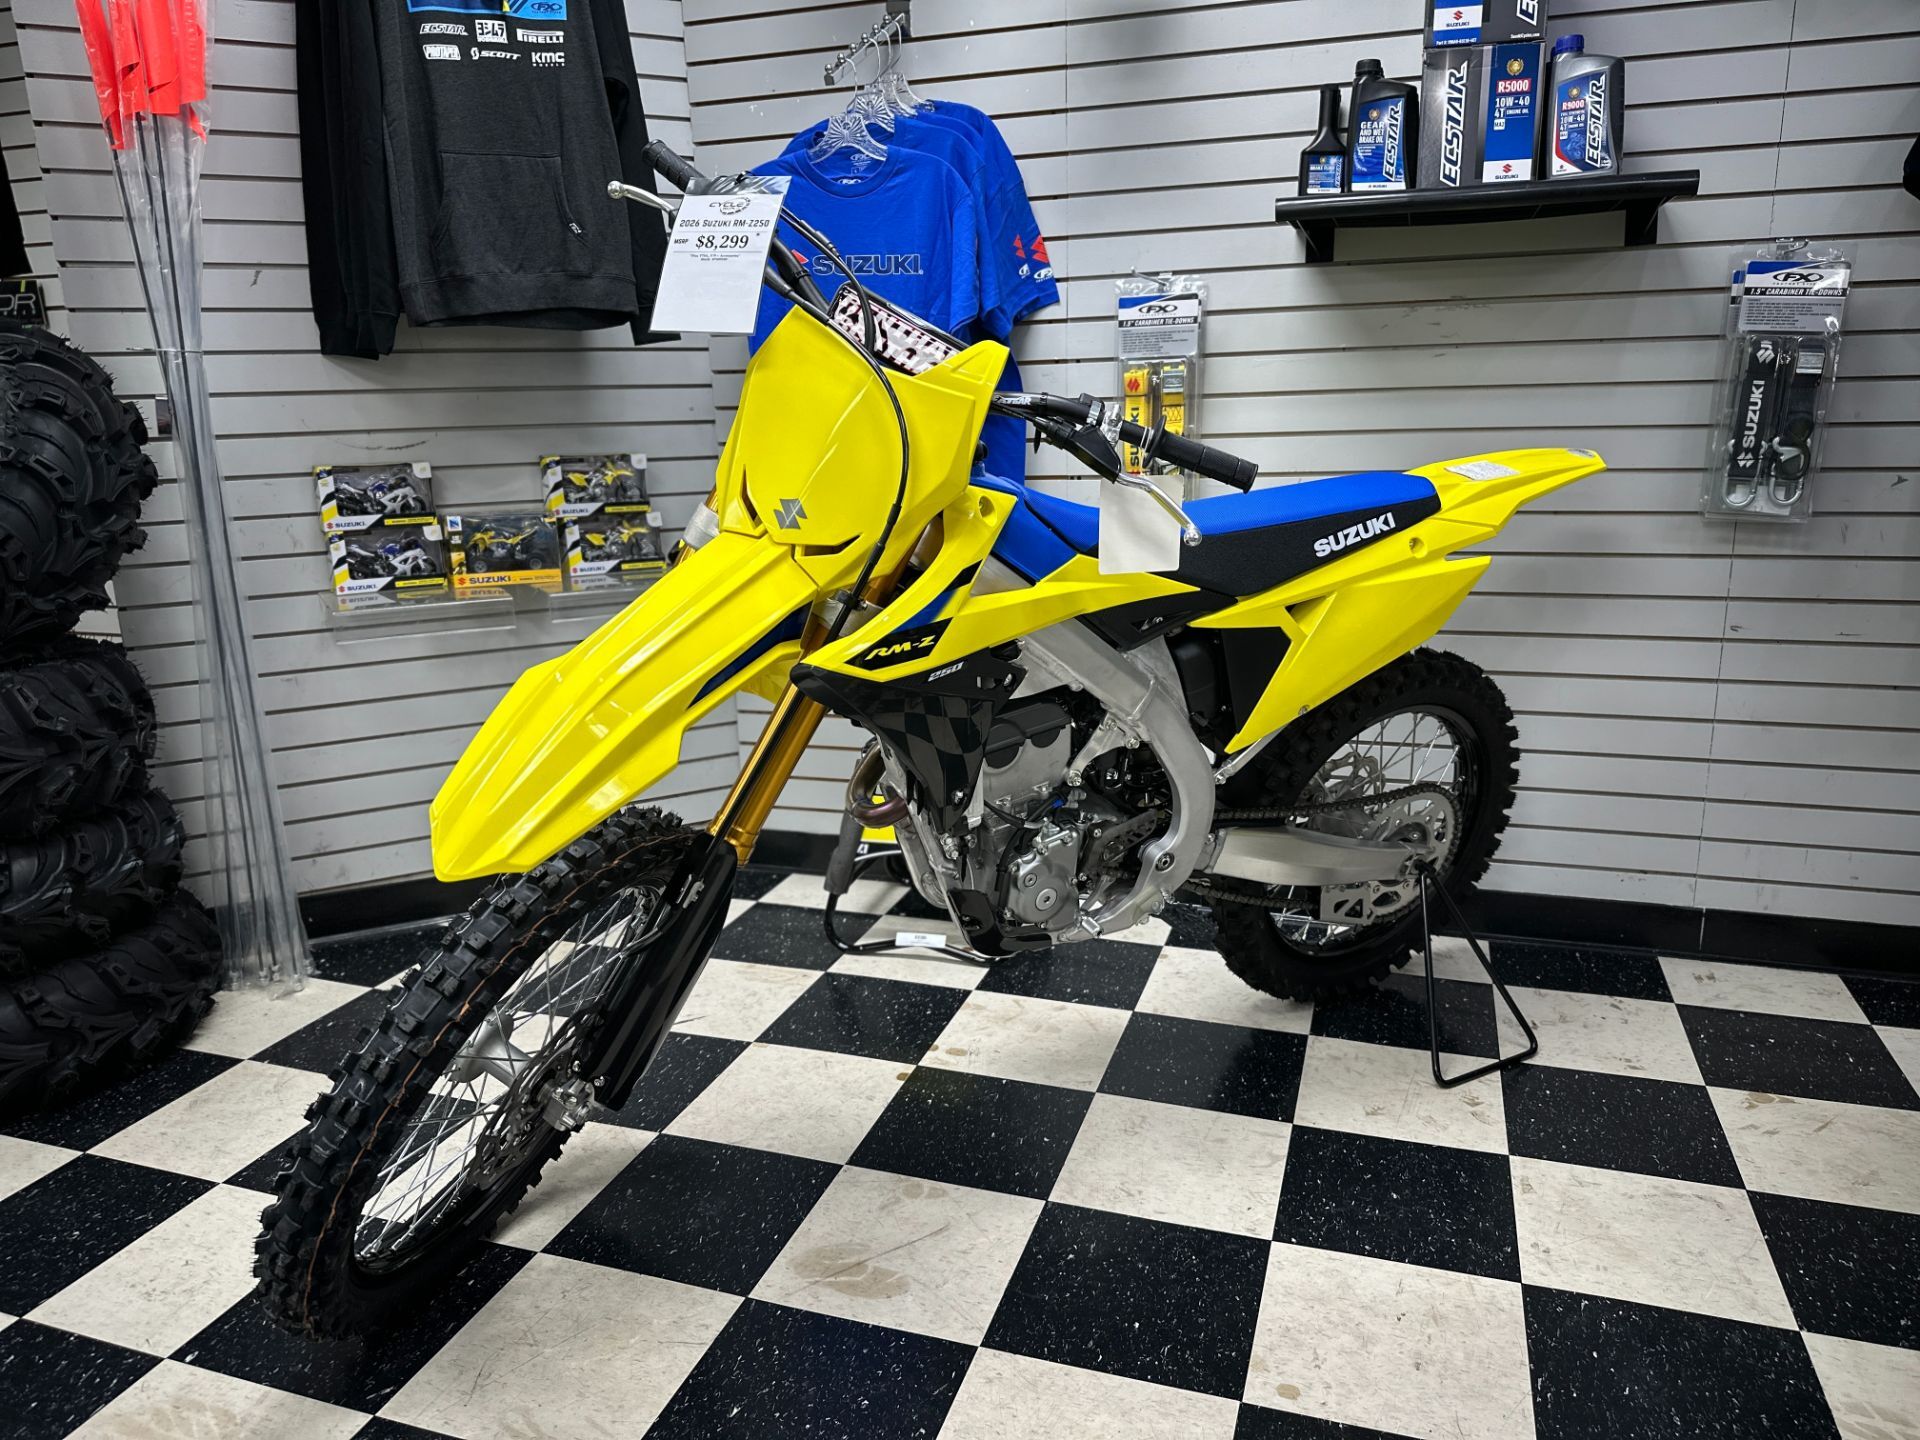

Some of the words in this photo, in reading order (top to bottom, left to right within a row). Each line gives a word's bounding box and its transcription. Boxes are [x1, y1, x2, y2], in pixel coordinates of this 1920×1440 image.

[420, 23, 468, 35] ECSTAR
[477, 22, 504, 37] ヨシムラ
[516, 28, 564, 43] PIRELLI
[480, 50, 521, 60] SCOTT
[531, 52, 565, 63] KMC
[1498, 80, 1529, 93] R5000
[1495, 96, 1530, 108] 10W-40
[1562, 99, 1585, 110] R9000
[1494, 108, 1505, 118] 4T
[1360, 121, 1385, 129] GEAR
[1440, 60, 1468, 186] ECSTAR
[1585, 73, 1606, 168] ECSTAR
[1360, 128, 1372, 136] AND
[1382, 100, 1403, 182] ECSTAR
[680, 219, 700, 228] 2026
[702, 219, 731, 227] SUZUKI
[733, 219, 770, 228] RM-Z250
[696, 234, 749, 251] $8,299
[812, 254, 921, 275] SUZUKI
[1766, 288, 1804, 296] CARABINER
[1805, 288, 1844, 296] TIE-DOWNS
[1134, 318, 1165, 327] CARABINER
[1165, 317, 1195, 325] TIE-DOWNS
[1742, 380, 1765, 448] SUZUKI
[1130, 407, 1139, 467] SUKI
[1313, 511, 1396, 557] SUZUKI
[469, 575, 511, 584] SUZUKI
[864, 634, 936, 661] RM-Z
[927, 661, 964, 682] 250
